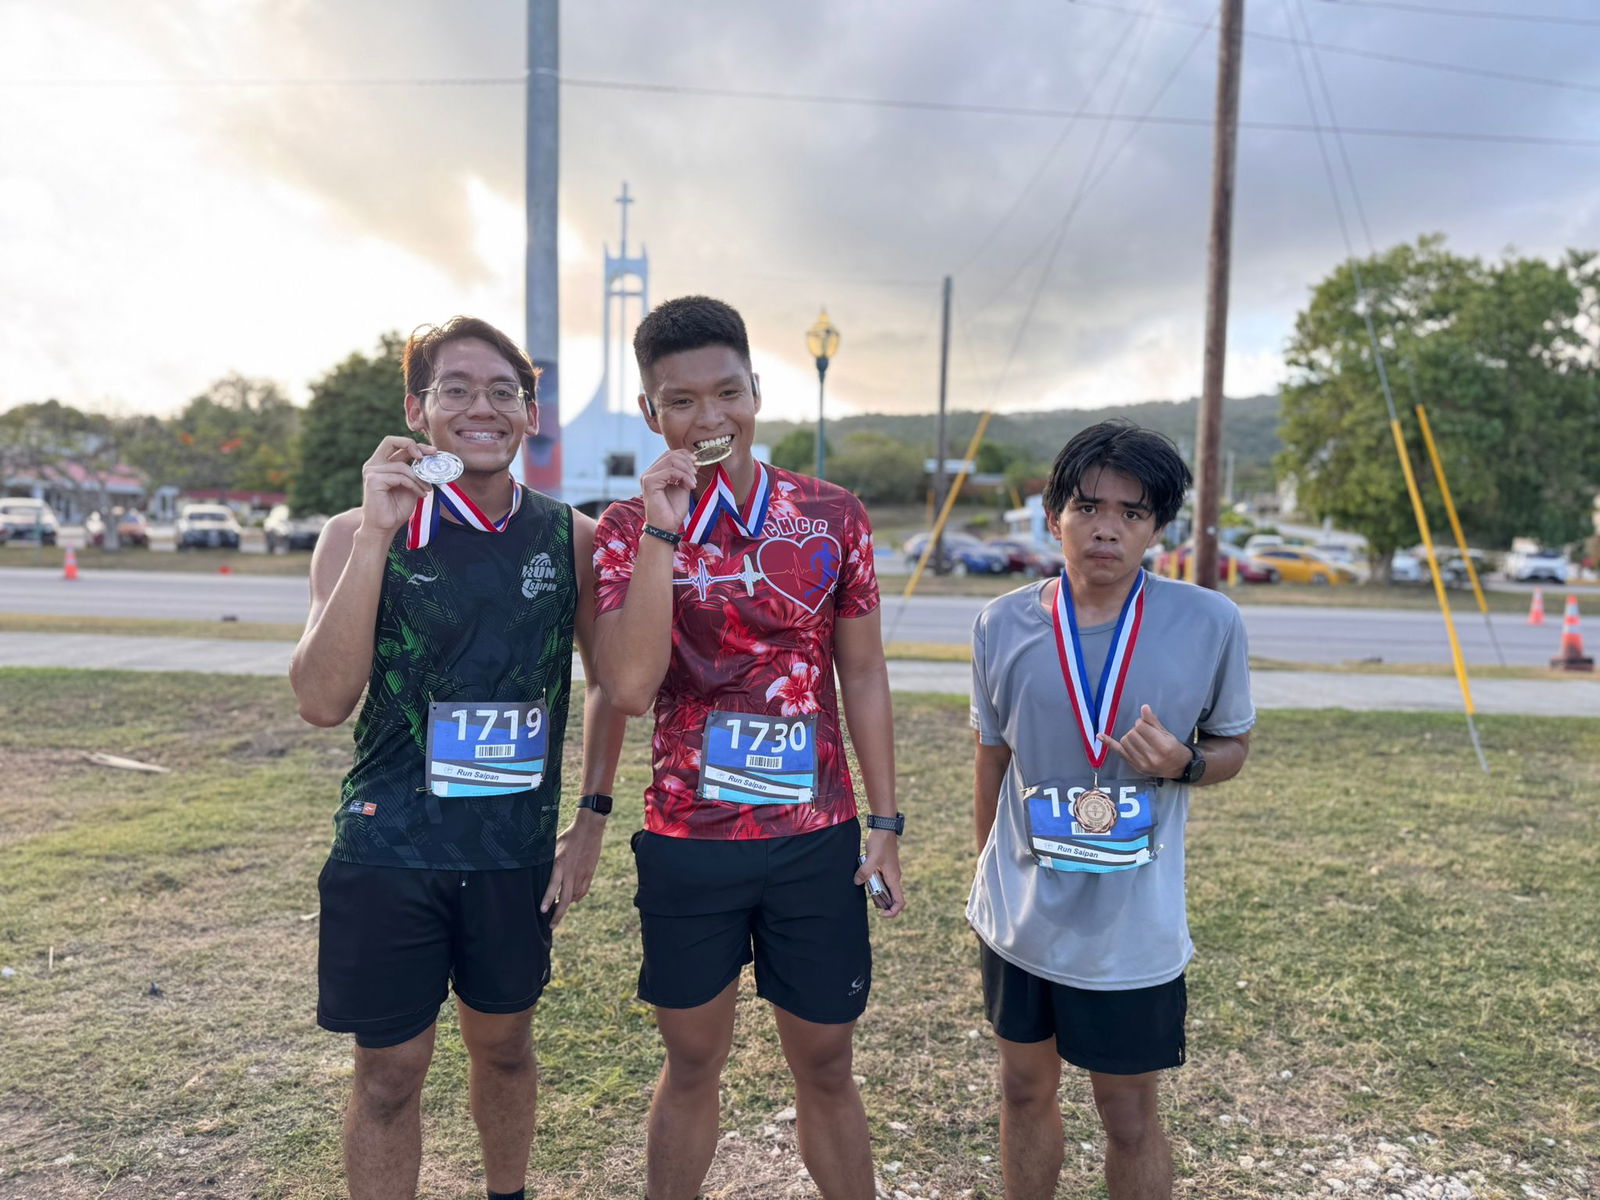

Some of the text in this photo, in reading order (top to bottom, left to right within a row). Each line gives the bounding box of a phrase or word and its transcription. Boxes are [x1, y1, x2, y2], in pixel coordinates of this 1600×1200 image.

[762, 517, 828, 538] CHCC
[522, 565, 556, 579] RUN
[530, 582, 557, 591] SAIPAN
[452, 707, 542, 740] 1719
[726, 719, 807, 753] 1730
[456, 769, 499, 781] Run Saipan
[728, 775, 767, 791] Run Saipan
[1043, 786, 1140, 818] 185
[1057, 845, 1099, 859] Run Saipan
